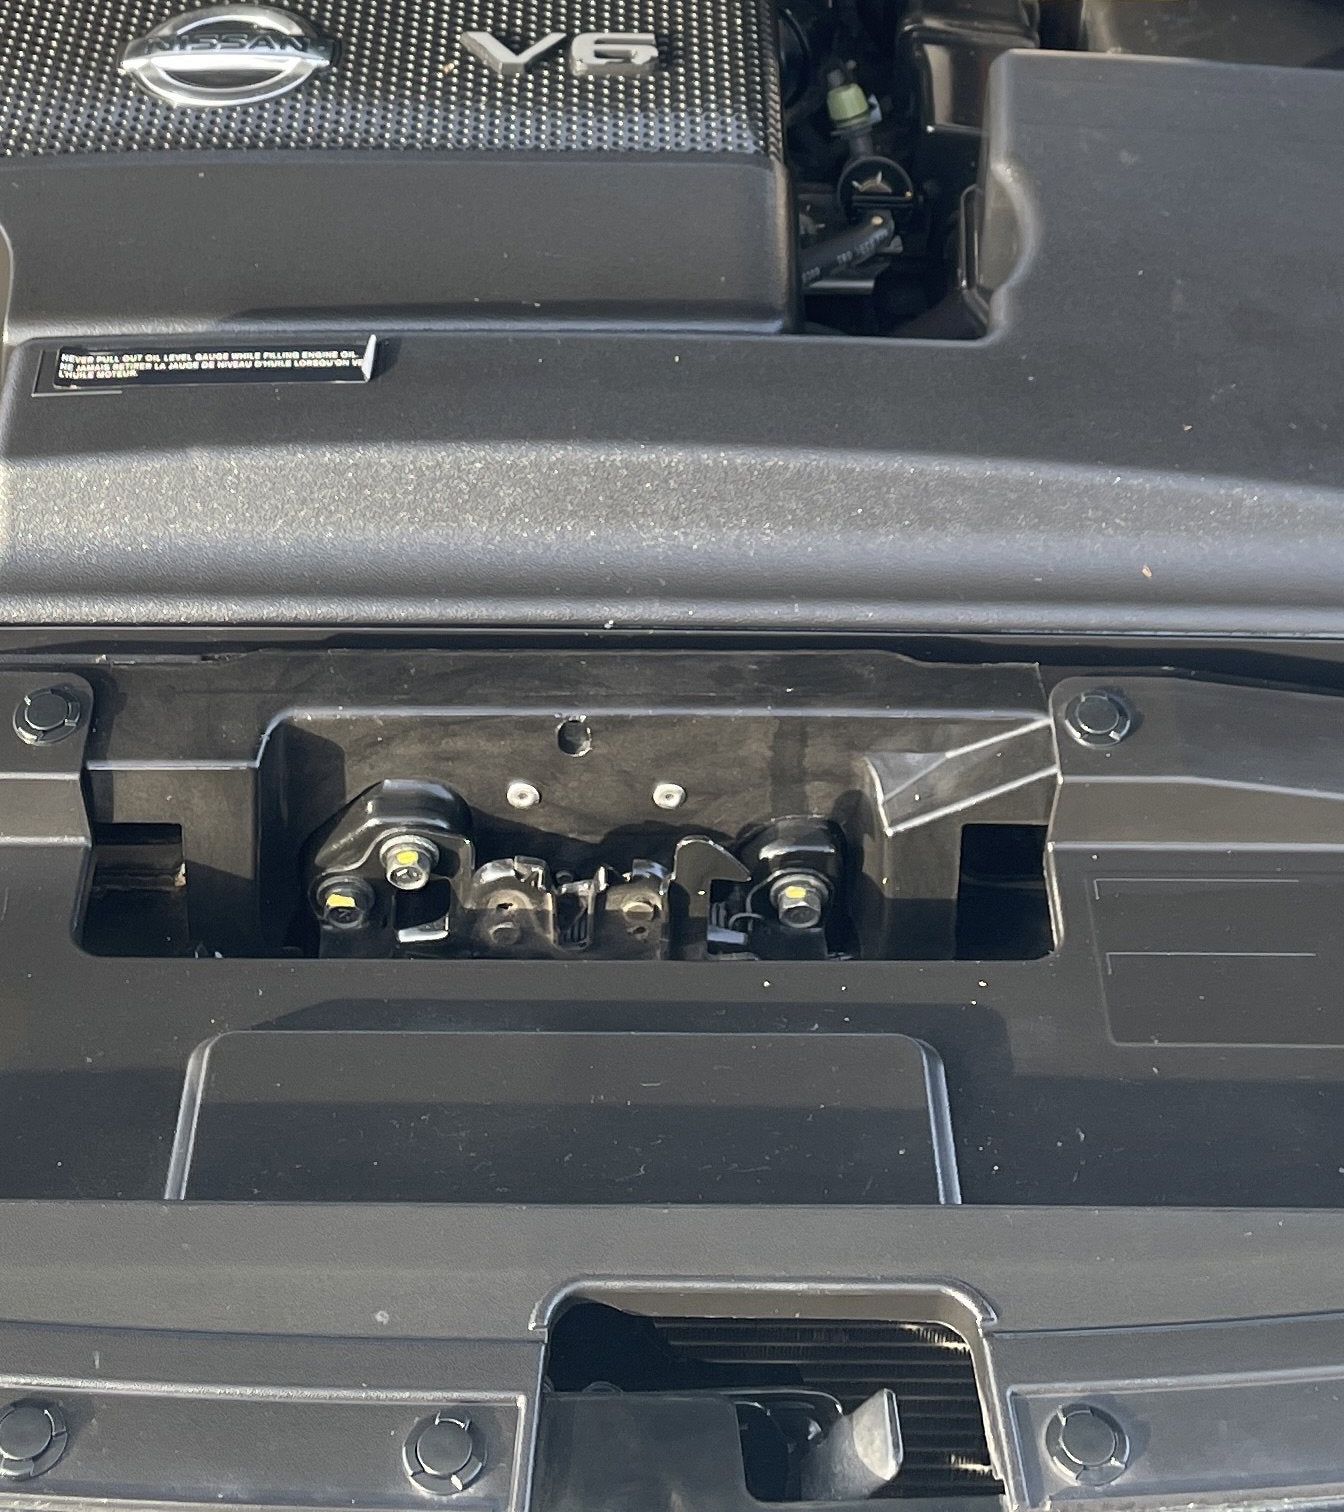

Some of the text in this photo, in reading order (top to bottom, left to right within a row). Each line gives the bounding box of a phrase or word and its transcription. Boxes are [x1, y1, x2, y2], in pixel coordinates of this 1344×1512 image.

[146, 33, 308, 53] NISSAN
[458, 31, 658, 76] V6
[61, 353, 94, 364] NEVER
[96, 354, 119, 363] PULL
[122, 354, 143, 363] OUT
[145, 354, 160, 362] OIL
[164, 353, 192, 362] LEVEL
[195, 352, 228, 361] GAUGE
[231, 351, 261, 360] WHILE
[263, 351, 299, 360] FILLING
[301, 350, 338, 359] ENGINE
[59, 362, 74, 372] NE
[76, 363, 110, 372] JAMAIS
[112, 362, 152, 370] RETIRER
[154, 362, 166, 370] LA
[168, 361, 199, 370] JAUGE
[201, 360, 214, 369] DE
[217, 360, 252, 369] NIVEAU
[254, 359, 291, 368] D'HUILE
[294, 358, 349, 367] LORSQU'ON
[58, 369, 138, 379] L'HUILE MOTEUR.
